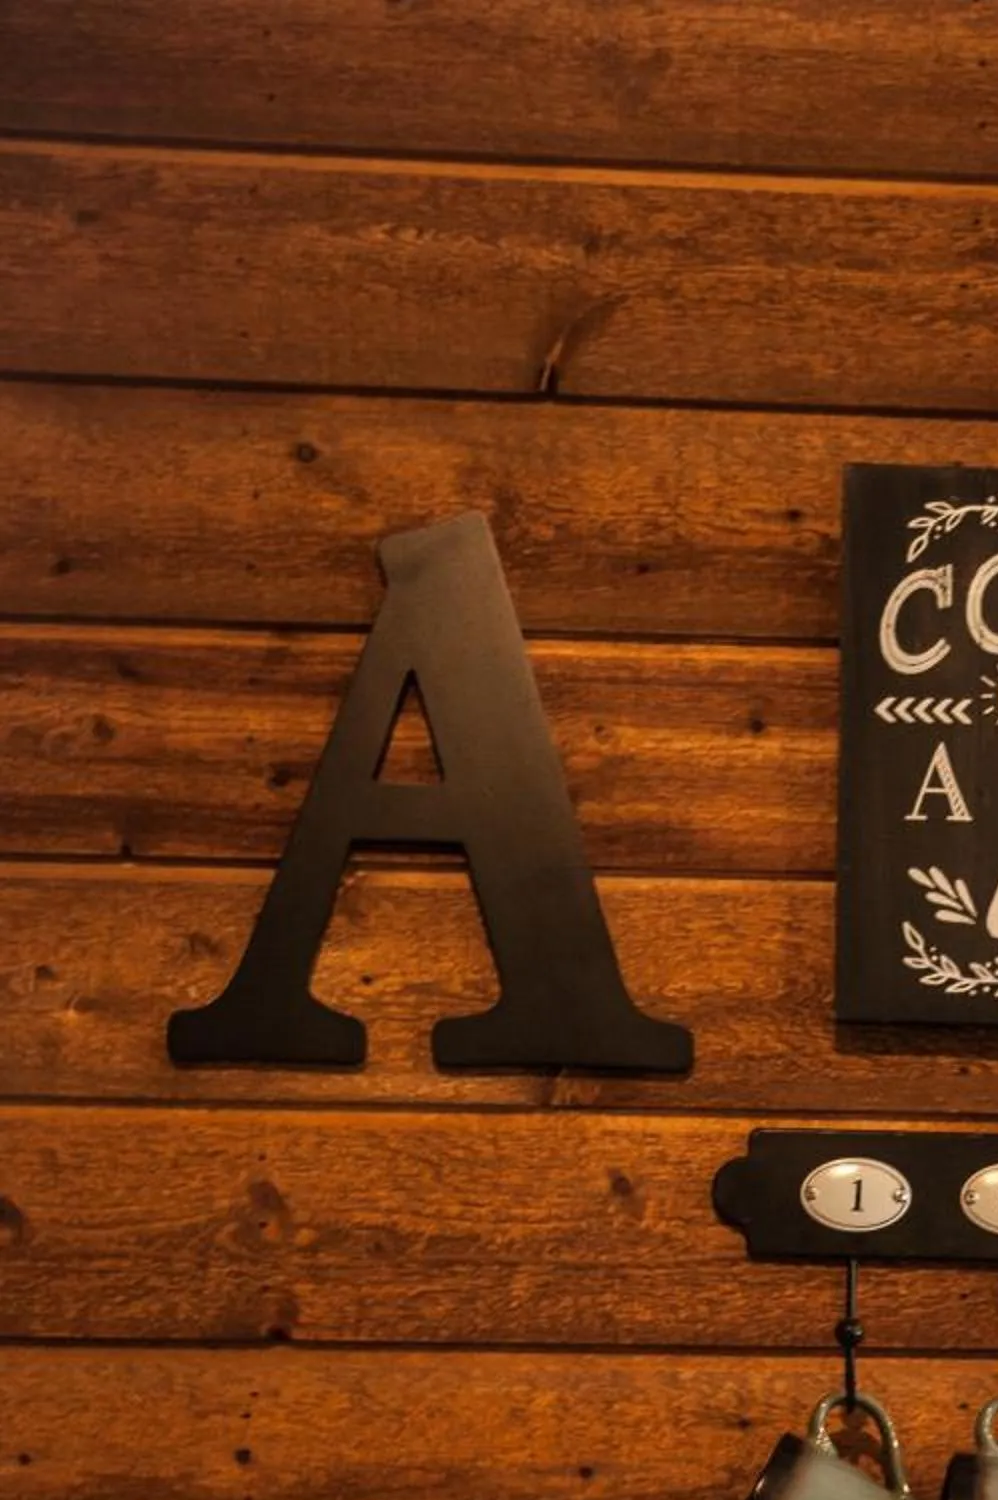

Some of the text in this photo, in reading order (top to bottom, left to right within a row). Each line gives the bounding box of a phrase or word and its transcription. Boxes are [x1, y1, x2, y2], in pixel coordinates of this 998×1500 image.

[167, 510, 694, 1078] A
[904, 741, 974, 822] A
[850, 1179, 864, 1212] 1
